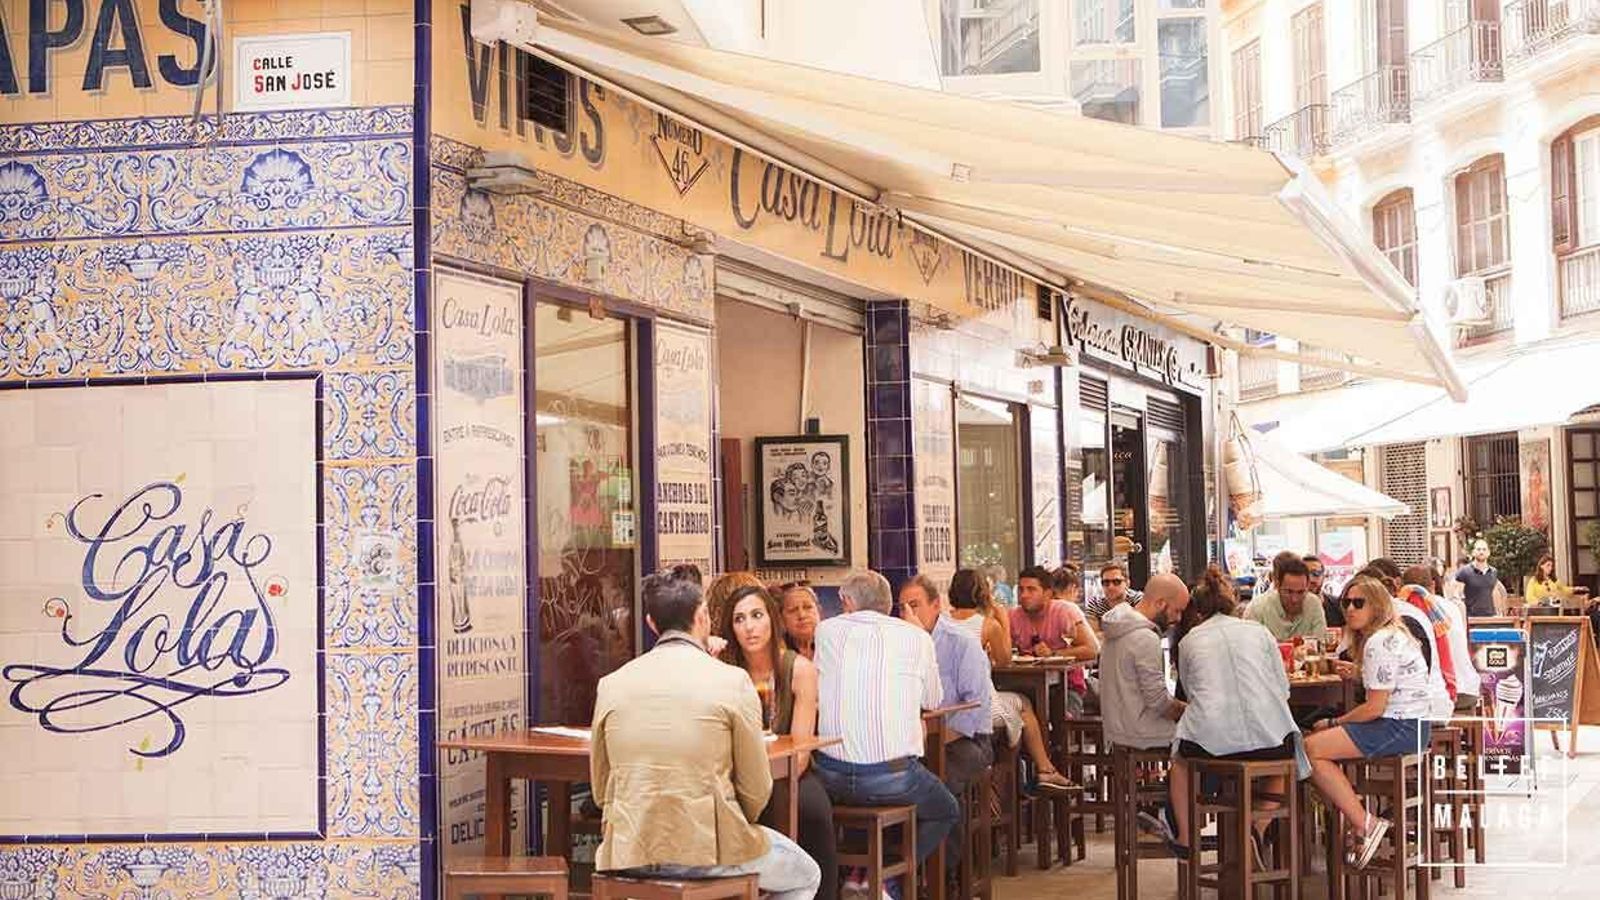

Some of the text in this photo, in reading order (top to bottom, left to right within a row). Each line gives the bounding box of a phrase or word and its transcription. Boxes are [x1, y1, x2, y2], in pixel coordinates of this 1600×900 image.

[0, 0, 216, 95] PAS
[253, 56, 293, 71] CALLE
[254, 69, 336, 93] SAN JOSÉ
[672, 146, 690, 185] 46
[730, 147, 894, 263] Casa Lola
[442, 297, 517, 336] Casa Lola
[65, 481, 272, 602] Casa
